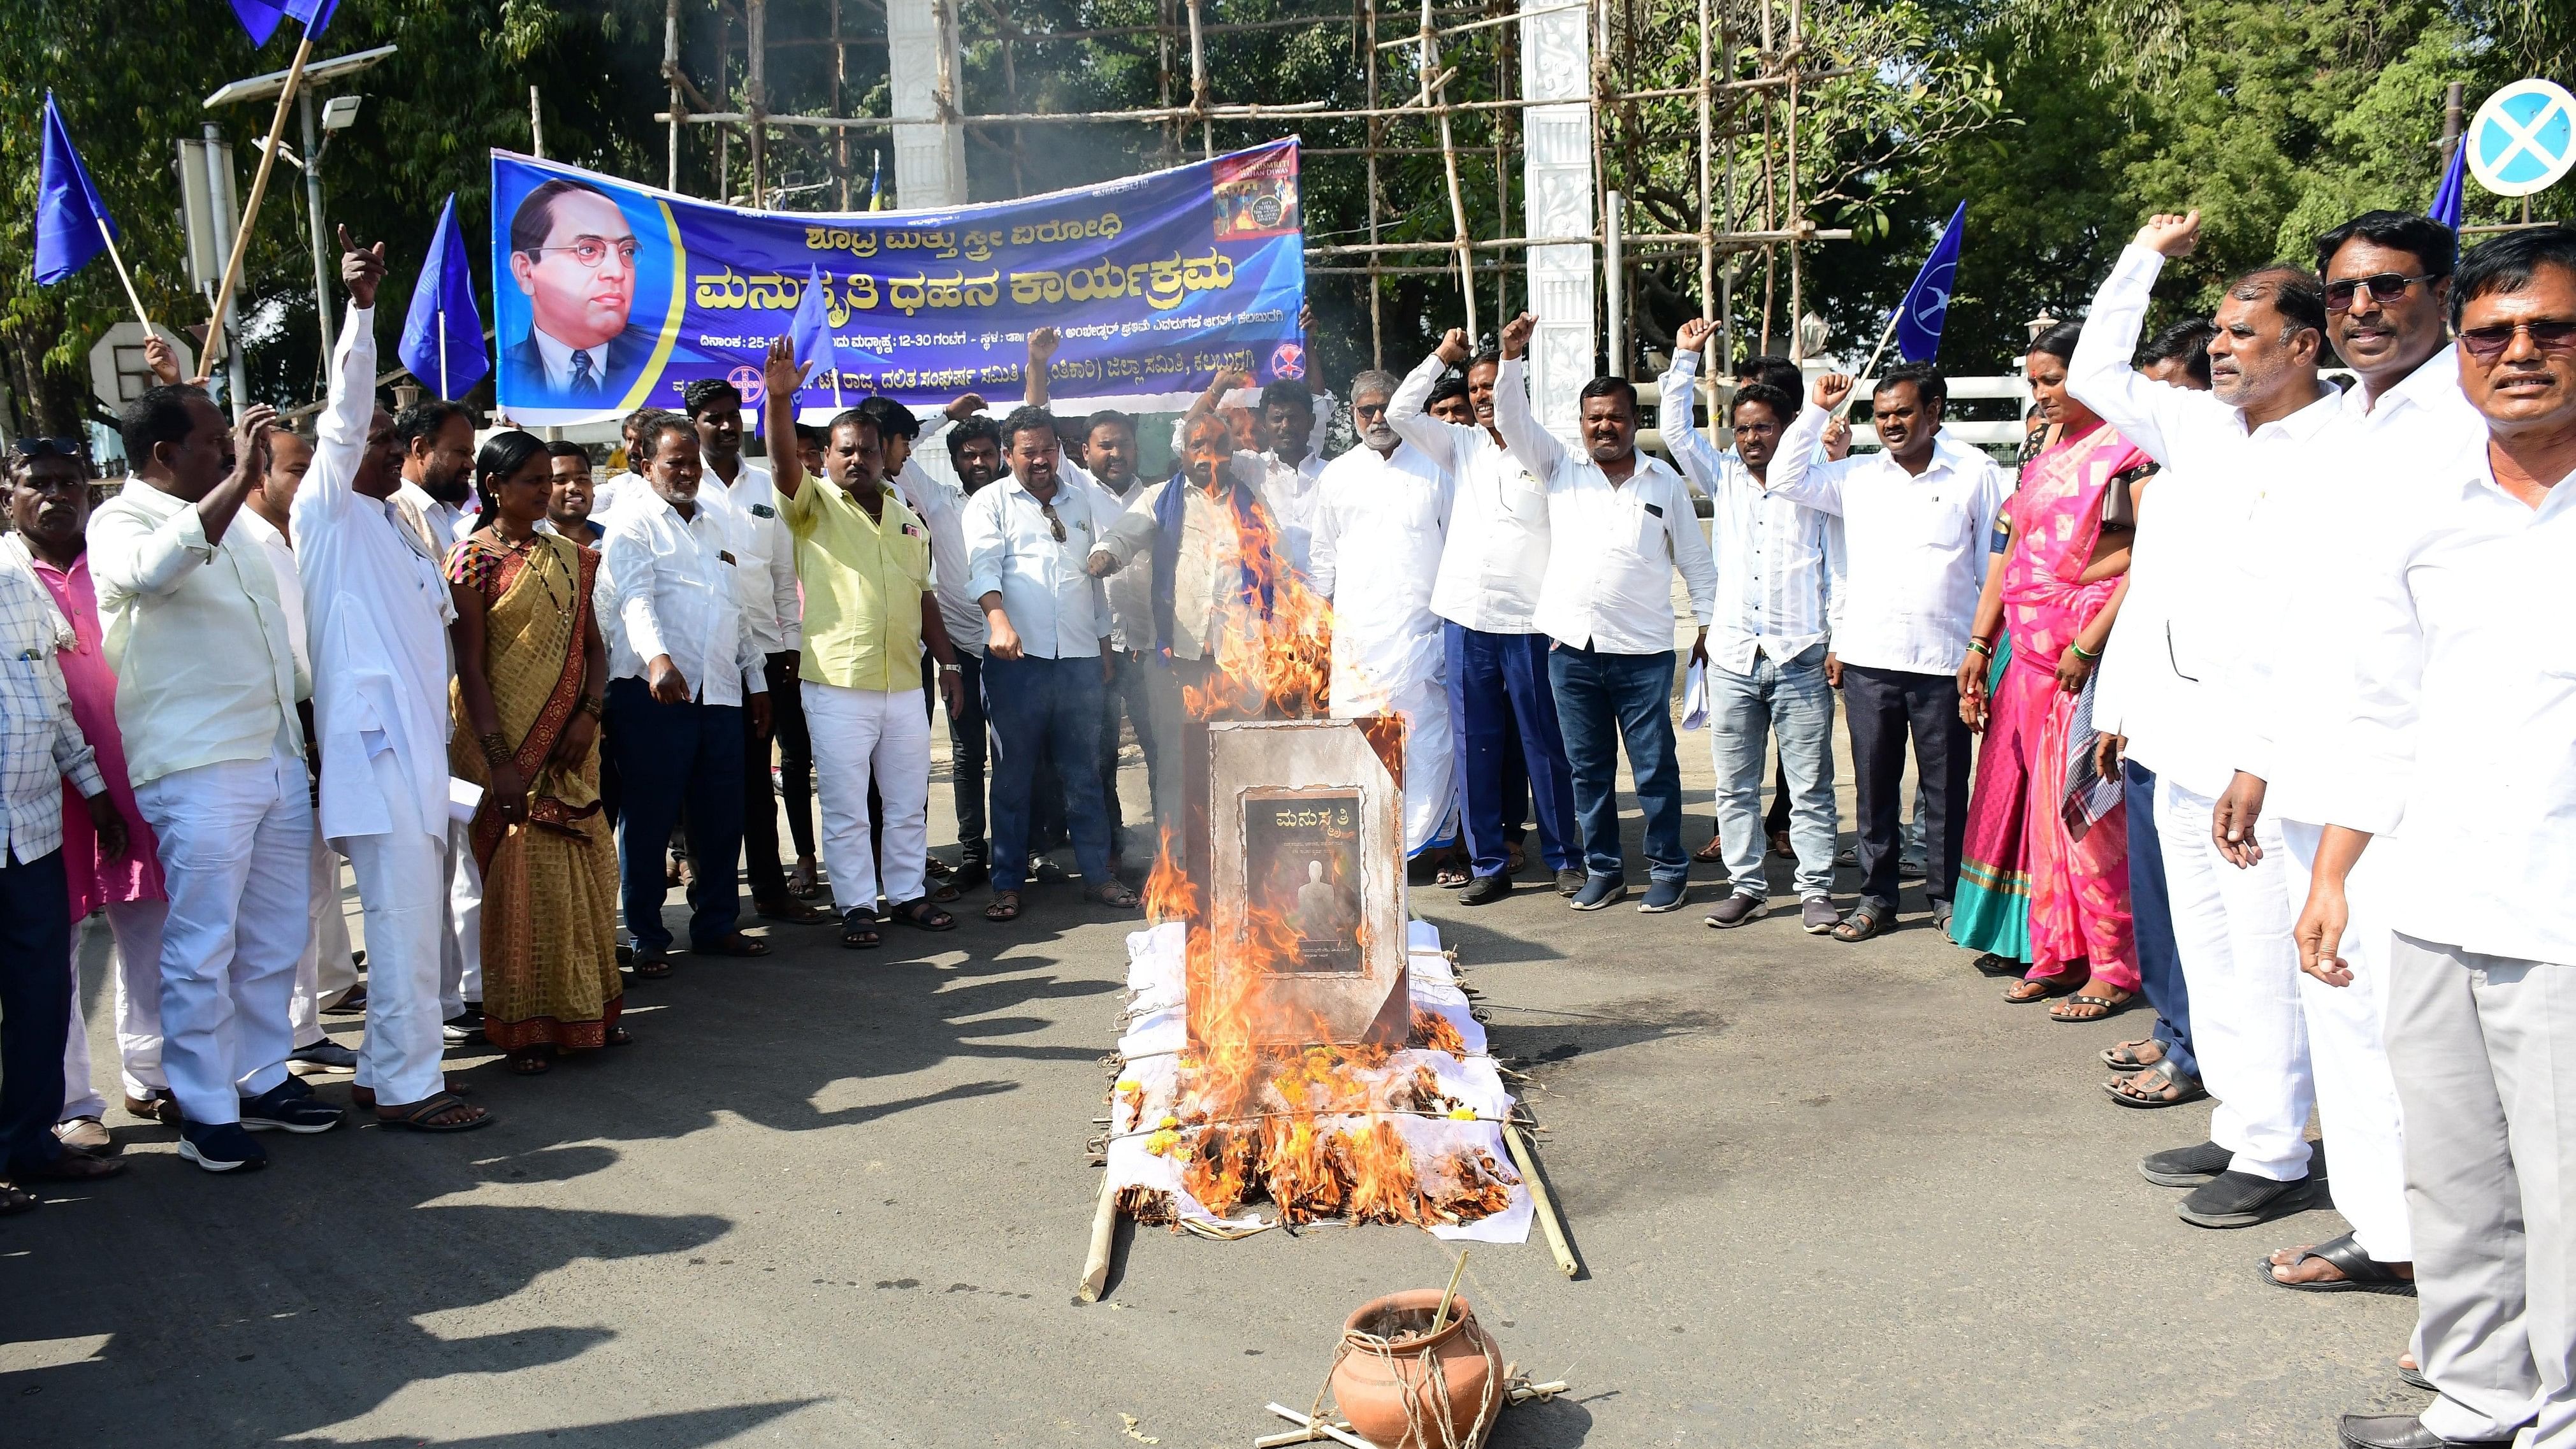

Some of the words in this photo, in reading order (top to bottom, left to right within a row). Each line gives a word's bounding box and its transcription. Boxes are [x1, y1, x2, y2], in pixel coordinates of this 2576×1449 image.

[1267, 167, 1289, 176] DIWAS
[805, 227, 878, 258] ಶೂದ್ರ
[885, 230, 959, 259] ಮತ್ತು
[963, 230, 1003, 261] ಸ್ತ್ರೀ
[1011, 212, 1123, 245] ವಿರೋಧಿ
[1009, 247, 1235, 310] ಕಾರ್ಯಕ್ರಮ
[899, 334, 932, 346] 12-30
[933, 331, 967, 346] ಗಂಟೆಗೆ
[1065, 322, 1119, 341] ಅಂಬೇಡ್ಕರ್
[881, 367, 917, 389] ದಲಿತ
[980, 363, 1019, 384] ಸಮಿತಿ
[1275, 807, 1349, 838] ಮನುಸ್ಮೃತಿ
